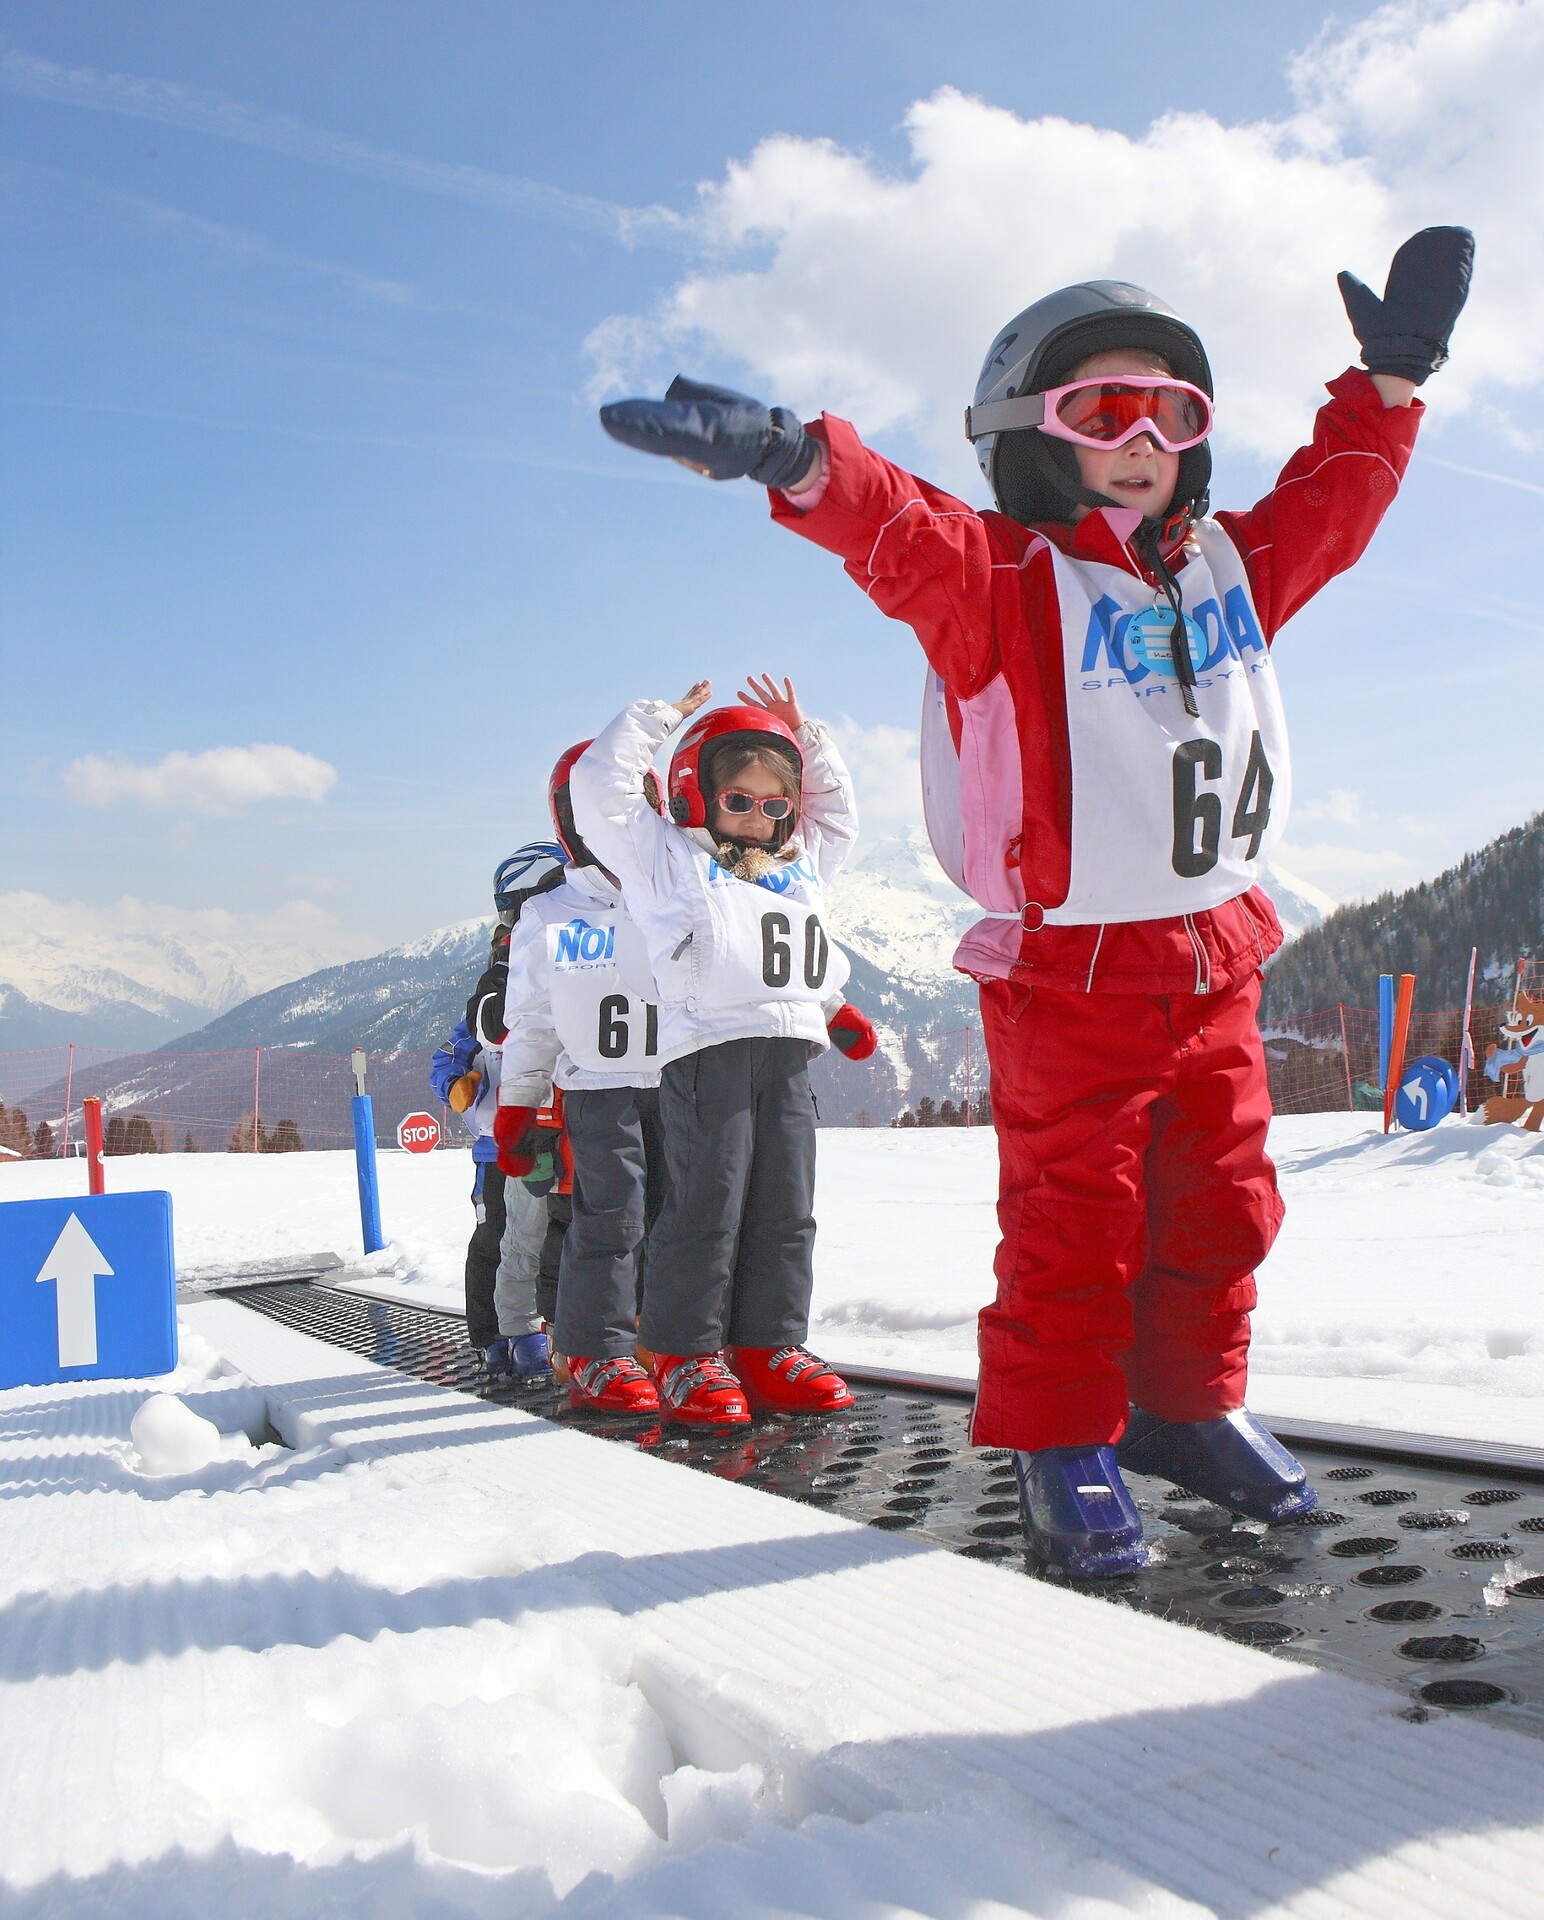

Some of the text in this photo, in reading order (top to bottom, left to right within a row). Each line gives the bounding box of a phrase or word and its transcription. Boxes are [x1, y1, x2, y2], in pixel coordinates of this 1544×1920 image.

[1172, 730, 1274, 878] 64
[761, 912, 828, 989] 60
[598, 994, 658, 1059] 61
[403, 1125, 437, 1143] STOP
